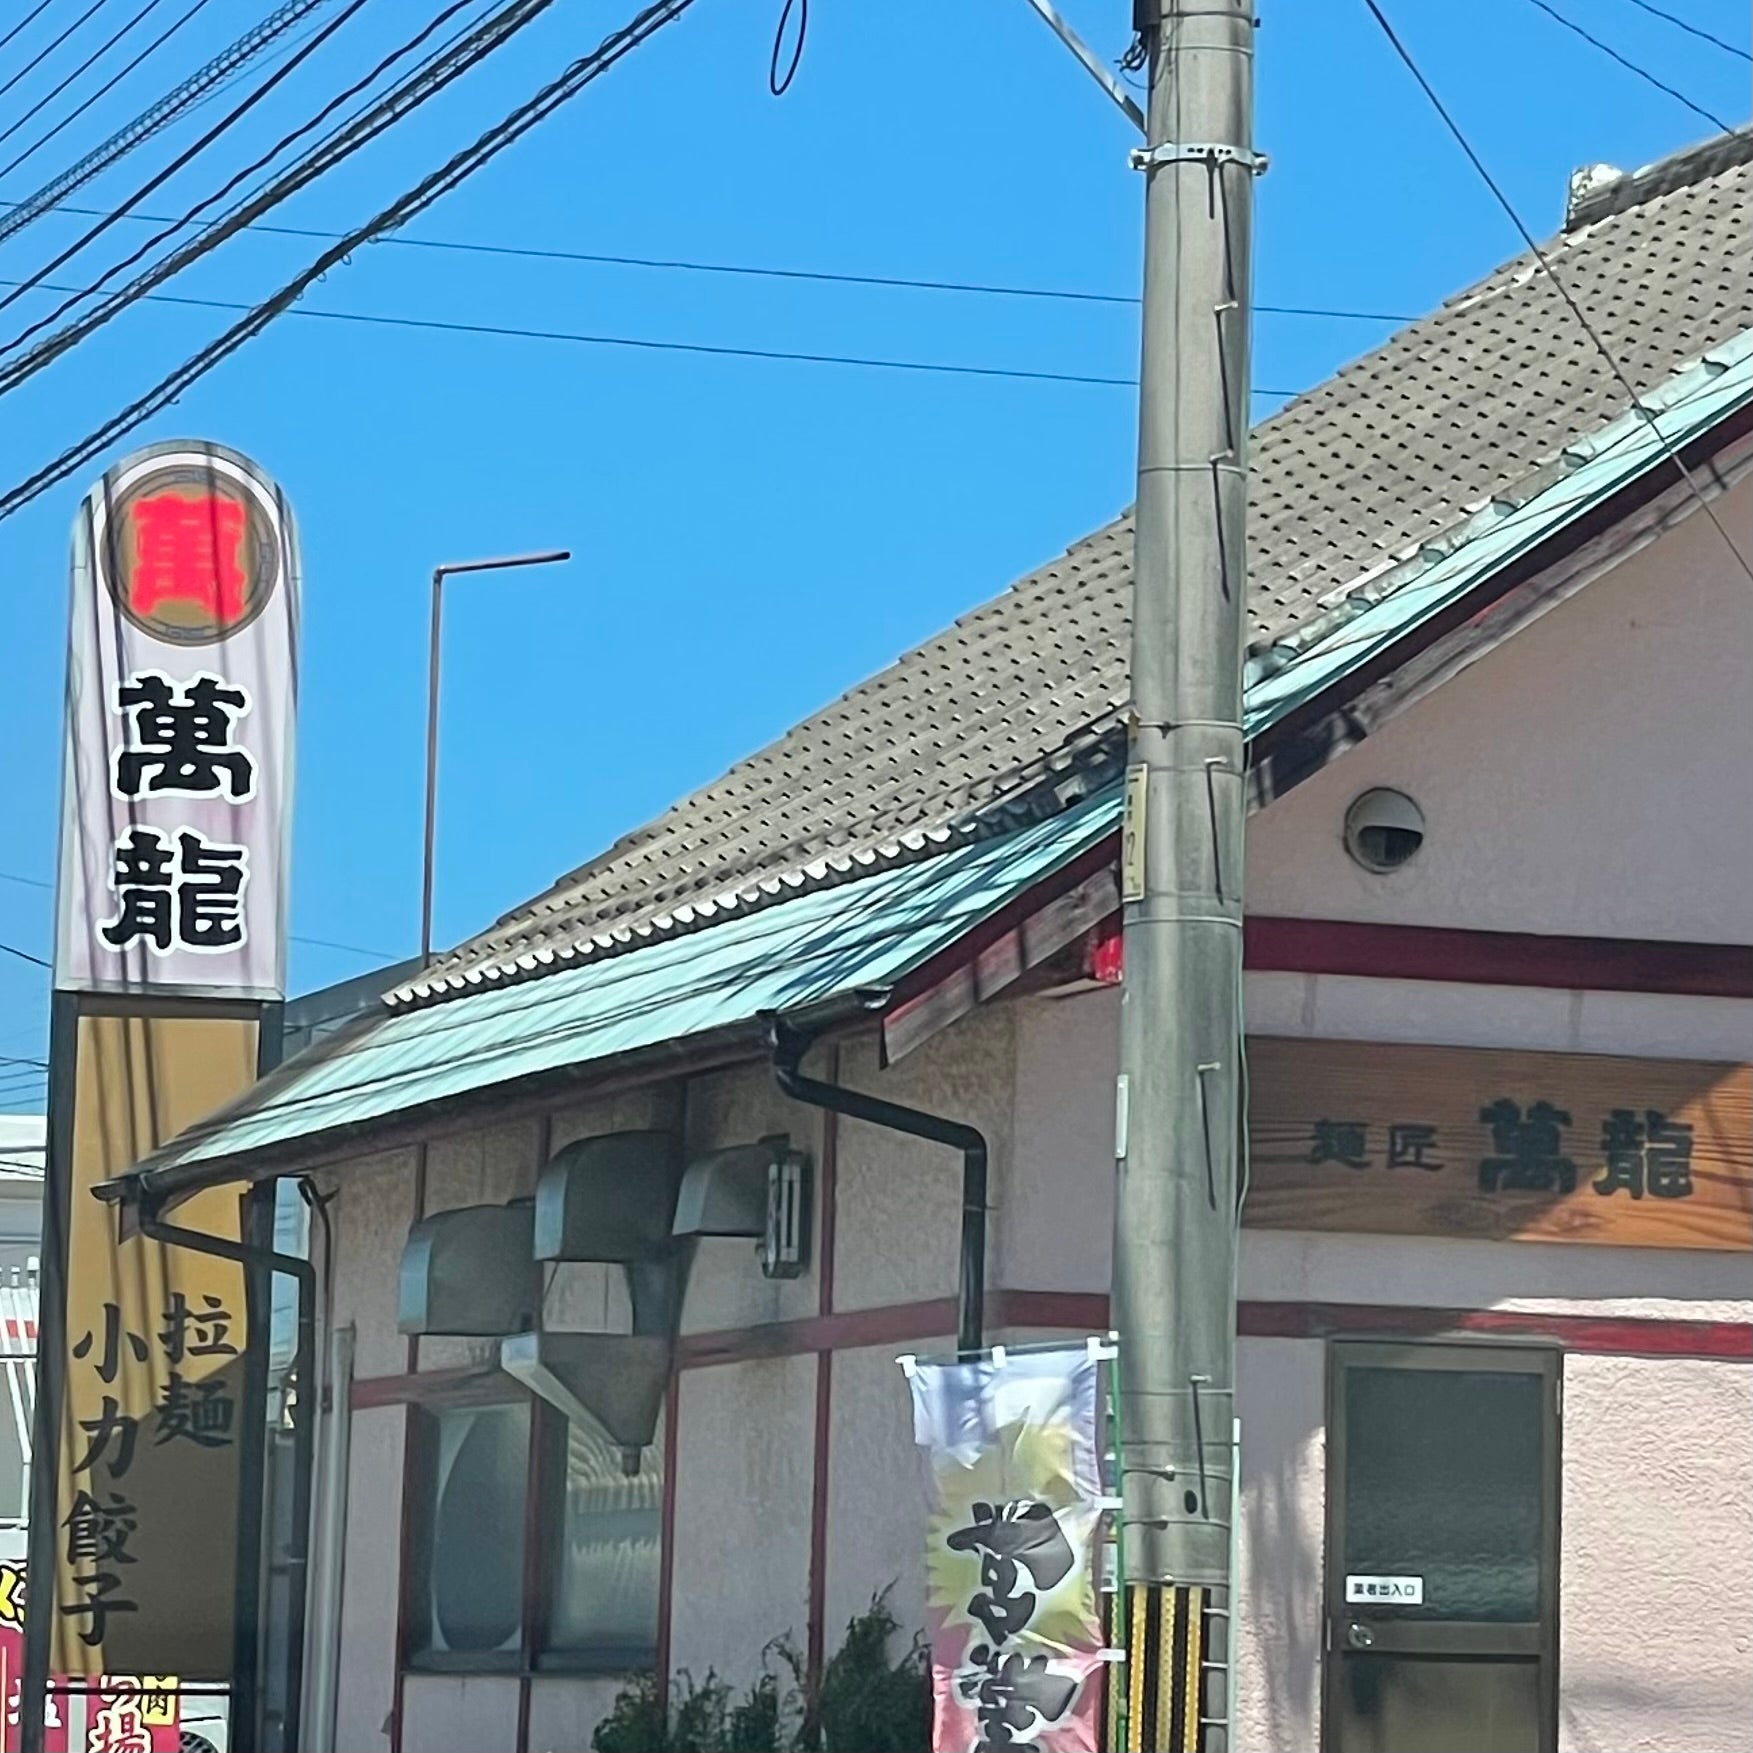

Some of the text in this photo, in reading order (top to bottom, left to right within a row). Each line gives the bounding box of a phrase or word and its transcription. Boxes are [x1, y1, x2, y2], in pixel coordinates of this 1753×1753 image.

[102, 674, 254, 950] 萬龍
[1477, 1097, 1695, 1201] 萬龍
[59, 1303, 149, 1648] 小力餃子
[154, 1291, 239, 1448] 拉麺
